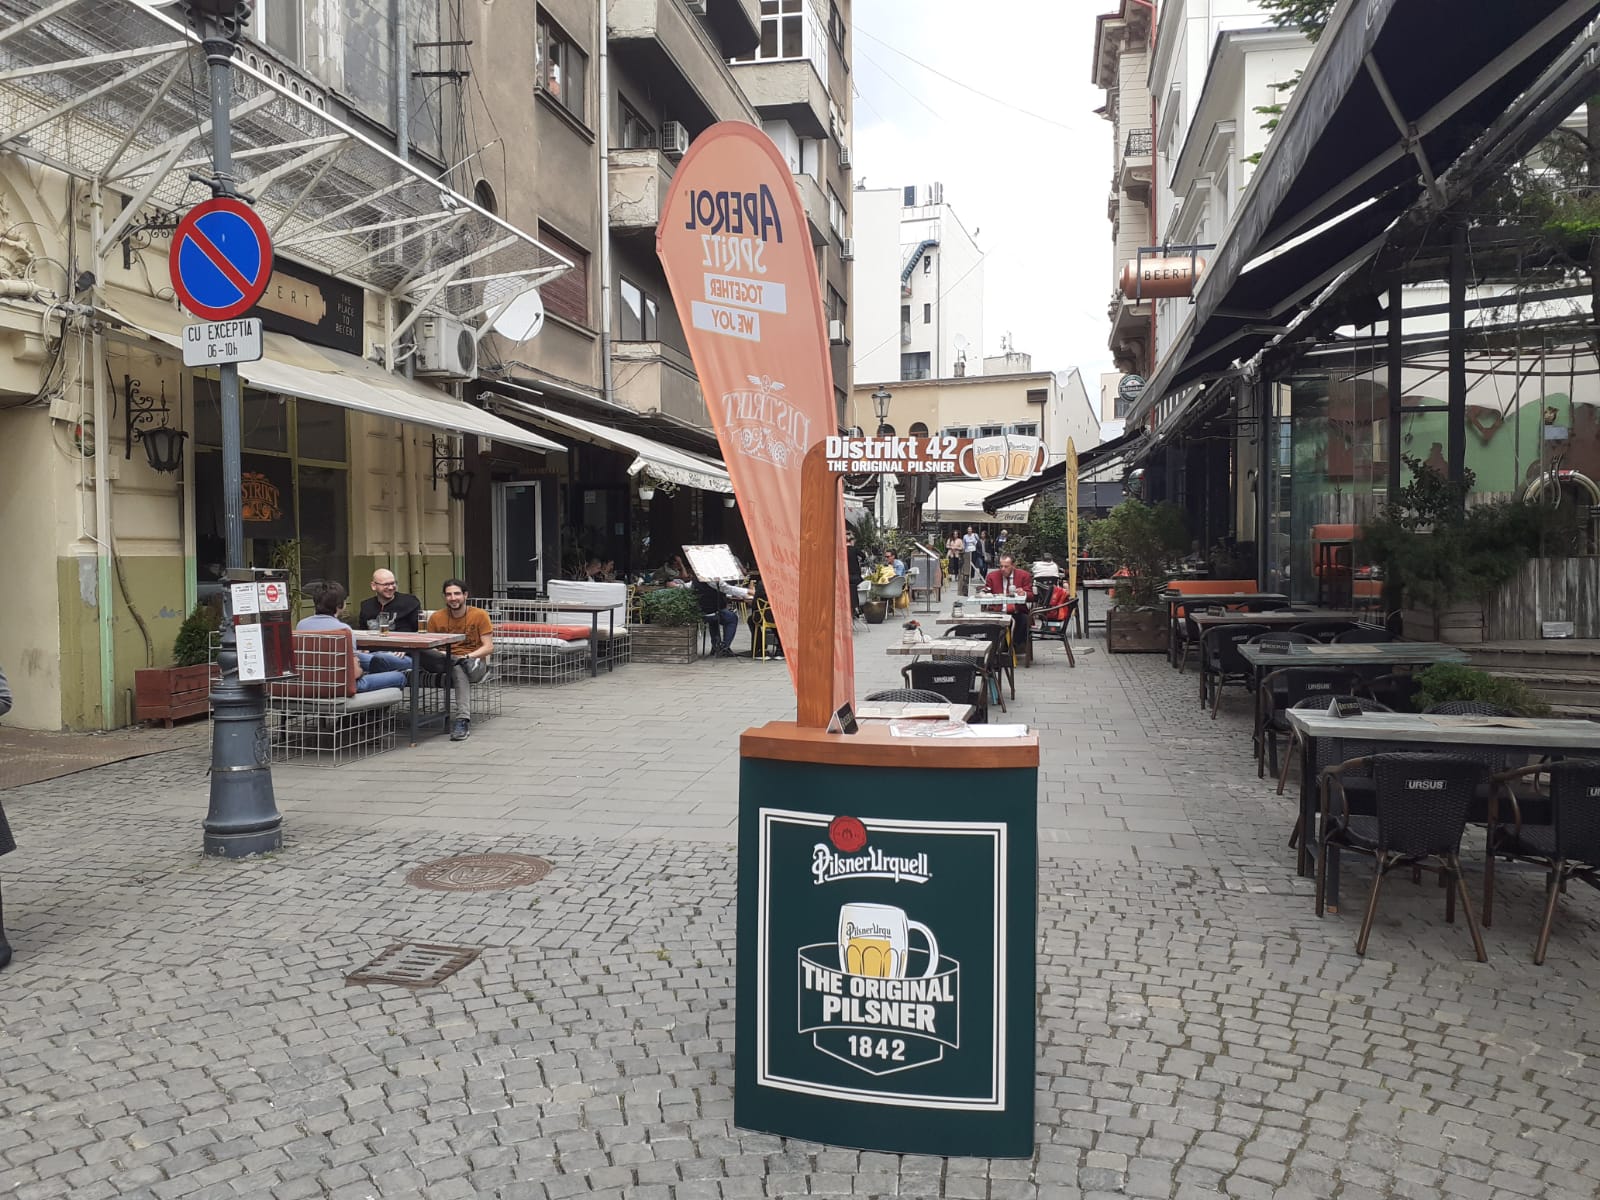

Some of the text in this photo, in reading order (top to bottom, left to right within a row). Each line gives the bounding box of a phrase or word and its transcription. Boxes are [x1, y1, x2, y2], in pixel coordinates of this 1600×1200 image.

[1144, 268, 1189, 280] BEERT
[337, 303, 355, 317] PLACE
[343, 314, 350, 326] TO
[188, 321, 253, 342] CU EXCEPTIA
[825, 435, 918, 460] Distrikt
[925, 436, 957, 460] 42
[827, 460, 955, 473] THE ORIGINAL PILSNER
[1408, 781, 1444, 790] URSUS
[802, 961, 954, 1002] THE ORIGINAL
[823, 995, 936, 1033] PILSNER
[848, 1035, 905, 1061] 1842
